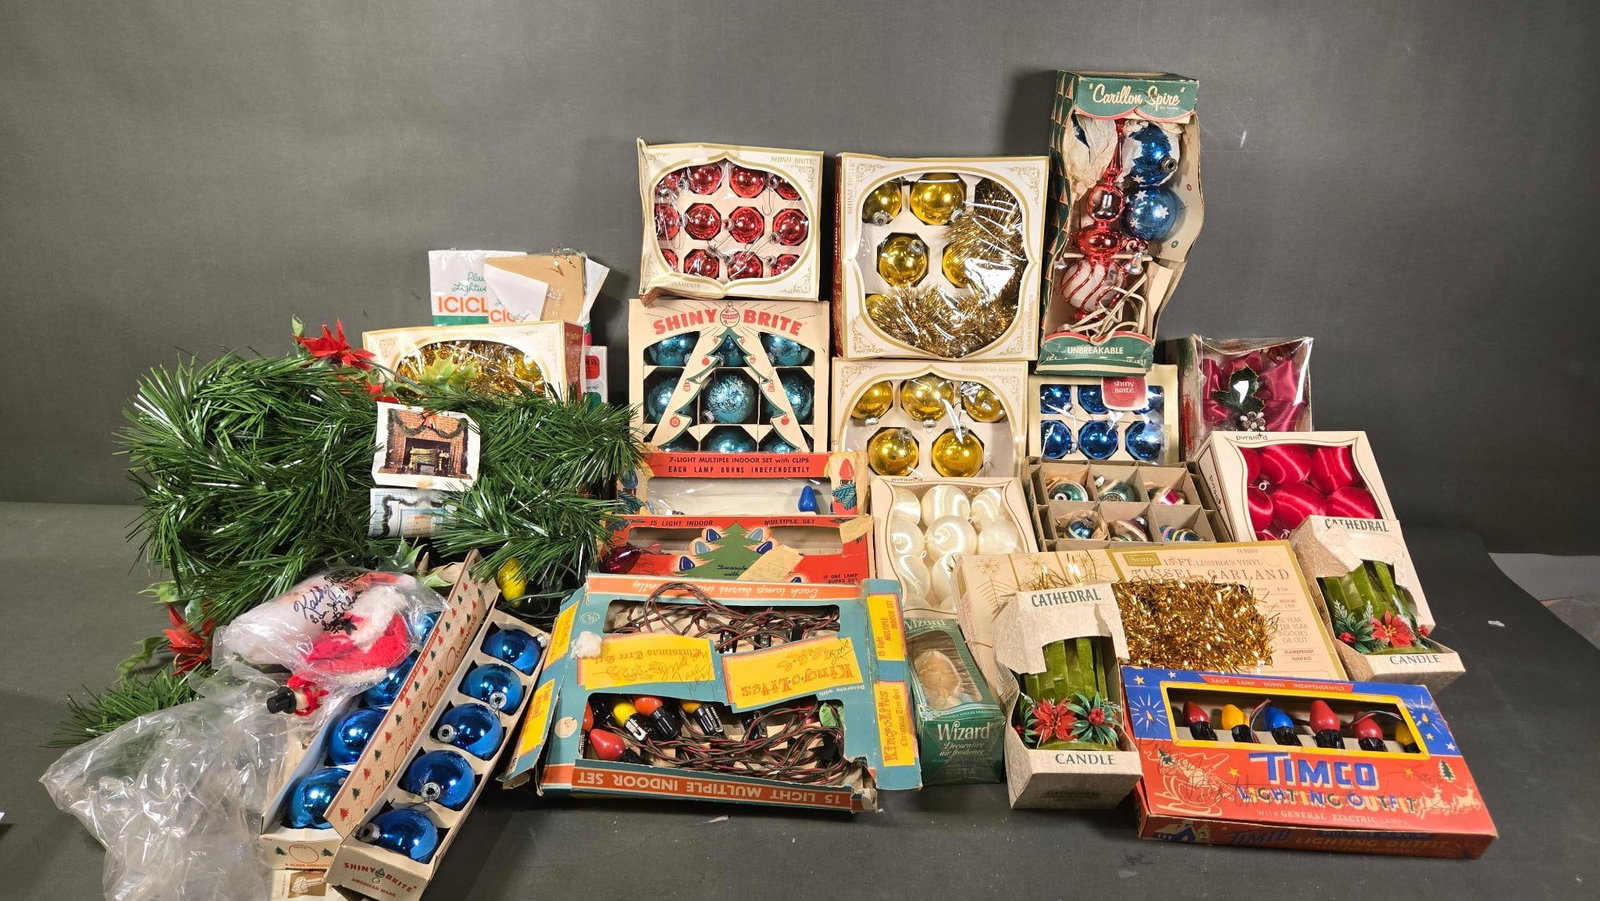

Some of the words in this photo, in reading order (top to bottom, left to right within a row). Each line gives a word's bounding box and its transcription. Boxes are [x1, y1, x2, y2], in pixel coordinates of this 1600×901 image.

[438, 295, 489, 313] ICICL
[653, 308, 718, 335] SHINY
[743, 309, 803, 336] BRITE
[1067, 346, 1124, 355] UNBREAKABLE
[699, 456, 729, 464] MULTIPLE
[650, 519, 658, 527] 15
[764, 518, 799, 526] MULTIPLE
[1207, 567, 1290, 581] GARLAND
[719, 585, 752, 597] burns
[757, 585, 786, 598] lamp
[790, 587, 819, 599] Each
[1031, 588, 1102, 608] CATHEDRAL
[618, 650, 643, 661] Tree
[646, 647, 702, 660] Christmas
[1389, 654, 1442, 665] CANDLE
[818, 688, 834, 697] with
[835, 684, 865, 693] Decorate
[937, 720, 991, 741] Wizard
[1055, 753, 1116, 766] CANDLE
[1248, 751, 1381, 791] TIMCO
[577, 771, 604, 785] SET
[612, 773, 679, 791] INDOOR
[686, 780, 762, 798] MULTIPLE
[770, 788, 816, 803] LIGHT
[825, 793, 841, 805] 15
[1237, 785, 1342, 808] LIGHTING
[1347, 793, 1421, 815] OUTFIT
[1281, 810, 1327, 820] GENERAL
[1332, 814, 1377, 824] ELECTRIC
[1296, 836, 1379, 848] LIGHTING
[1385, 838, 1449, 849] OUTFIT
[344, 862, 376, 873] SHINY
[385, 873, 413, 893] BRITE
[351, 878, 380, 892] AMERICAN
[380, 887, 397, 898] MADE
